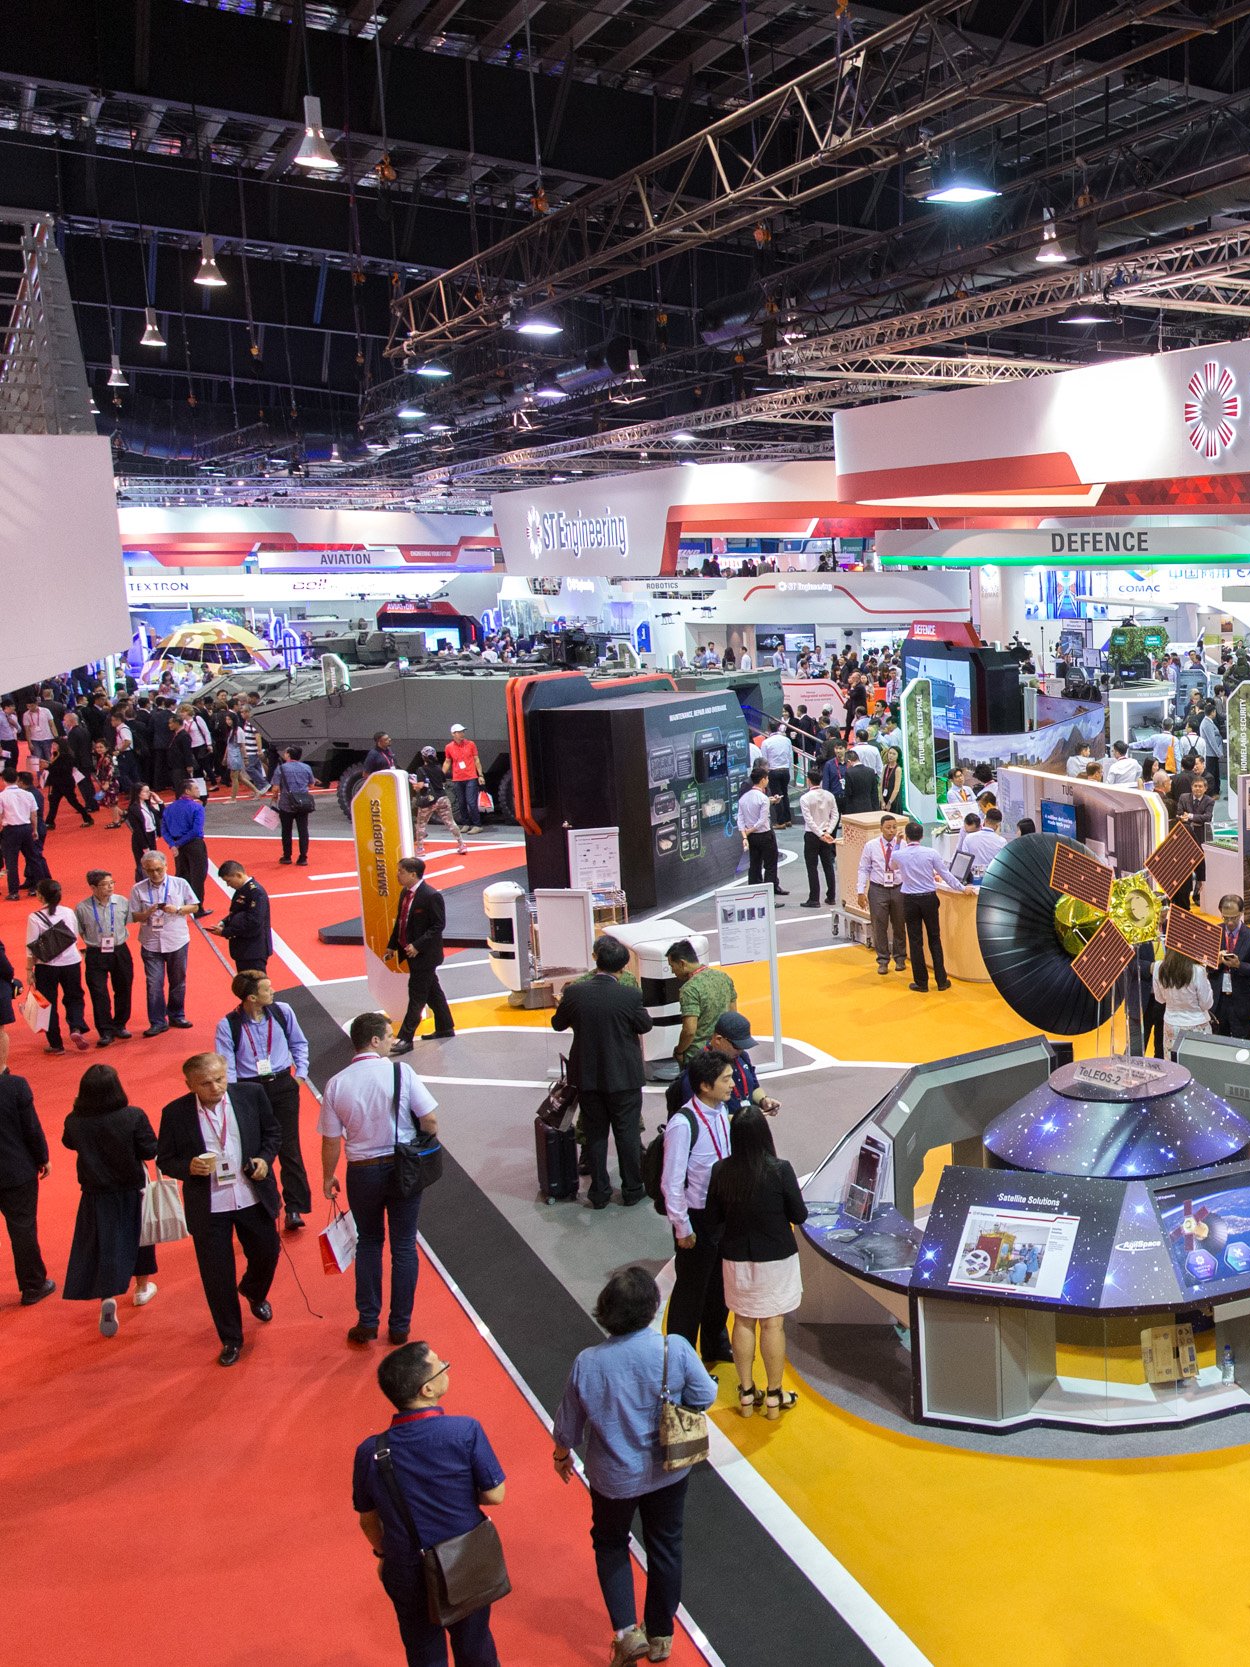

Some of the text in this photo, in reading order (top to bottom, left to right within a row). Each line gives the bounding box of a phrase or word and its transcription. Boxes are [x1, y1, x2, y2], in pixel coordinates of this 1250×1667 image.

[542, 506, 629, 558] ST Engineering
[1051, 530, 1149, 553] DEFENCE
[320, 553, 371, 565] AVIATION
[128, 582, 190, 592] TEXTRON
[646, 581, 679, 590] ROBOTICS
[797, 581, 833, 592] Engineering
[1118, 584, 1161, 593] COMAC
[914, 623, 937, 636] DEFENCE
[1239, 698, 1247, 733] SECURITY
[916, 694, 925, 765] FUTURE BATTLESPACE
[371, 799, 389, 896] SMART ROBOTICS
[1078, 1066, 1121, 1086] TeLEOS-2
[997, 1193, 1060, 1207] Satellite Solutions
[1122, 1239, 1161, 1249] AgilSpace
